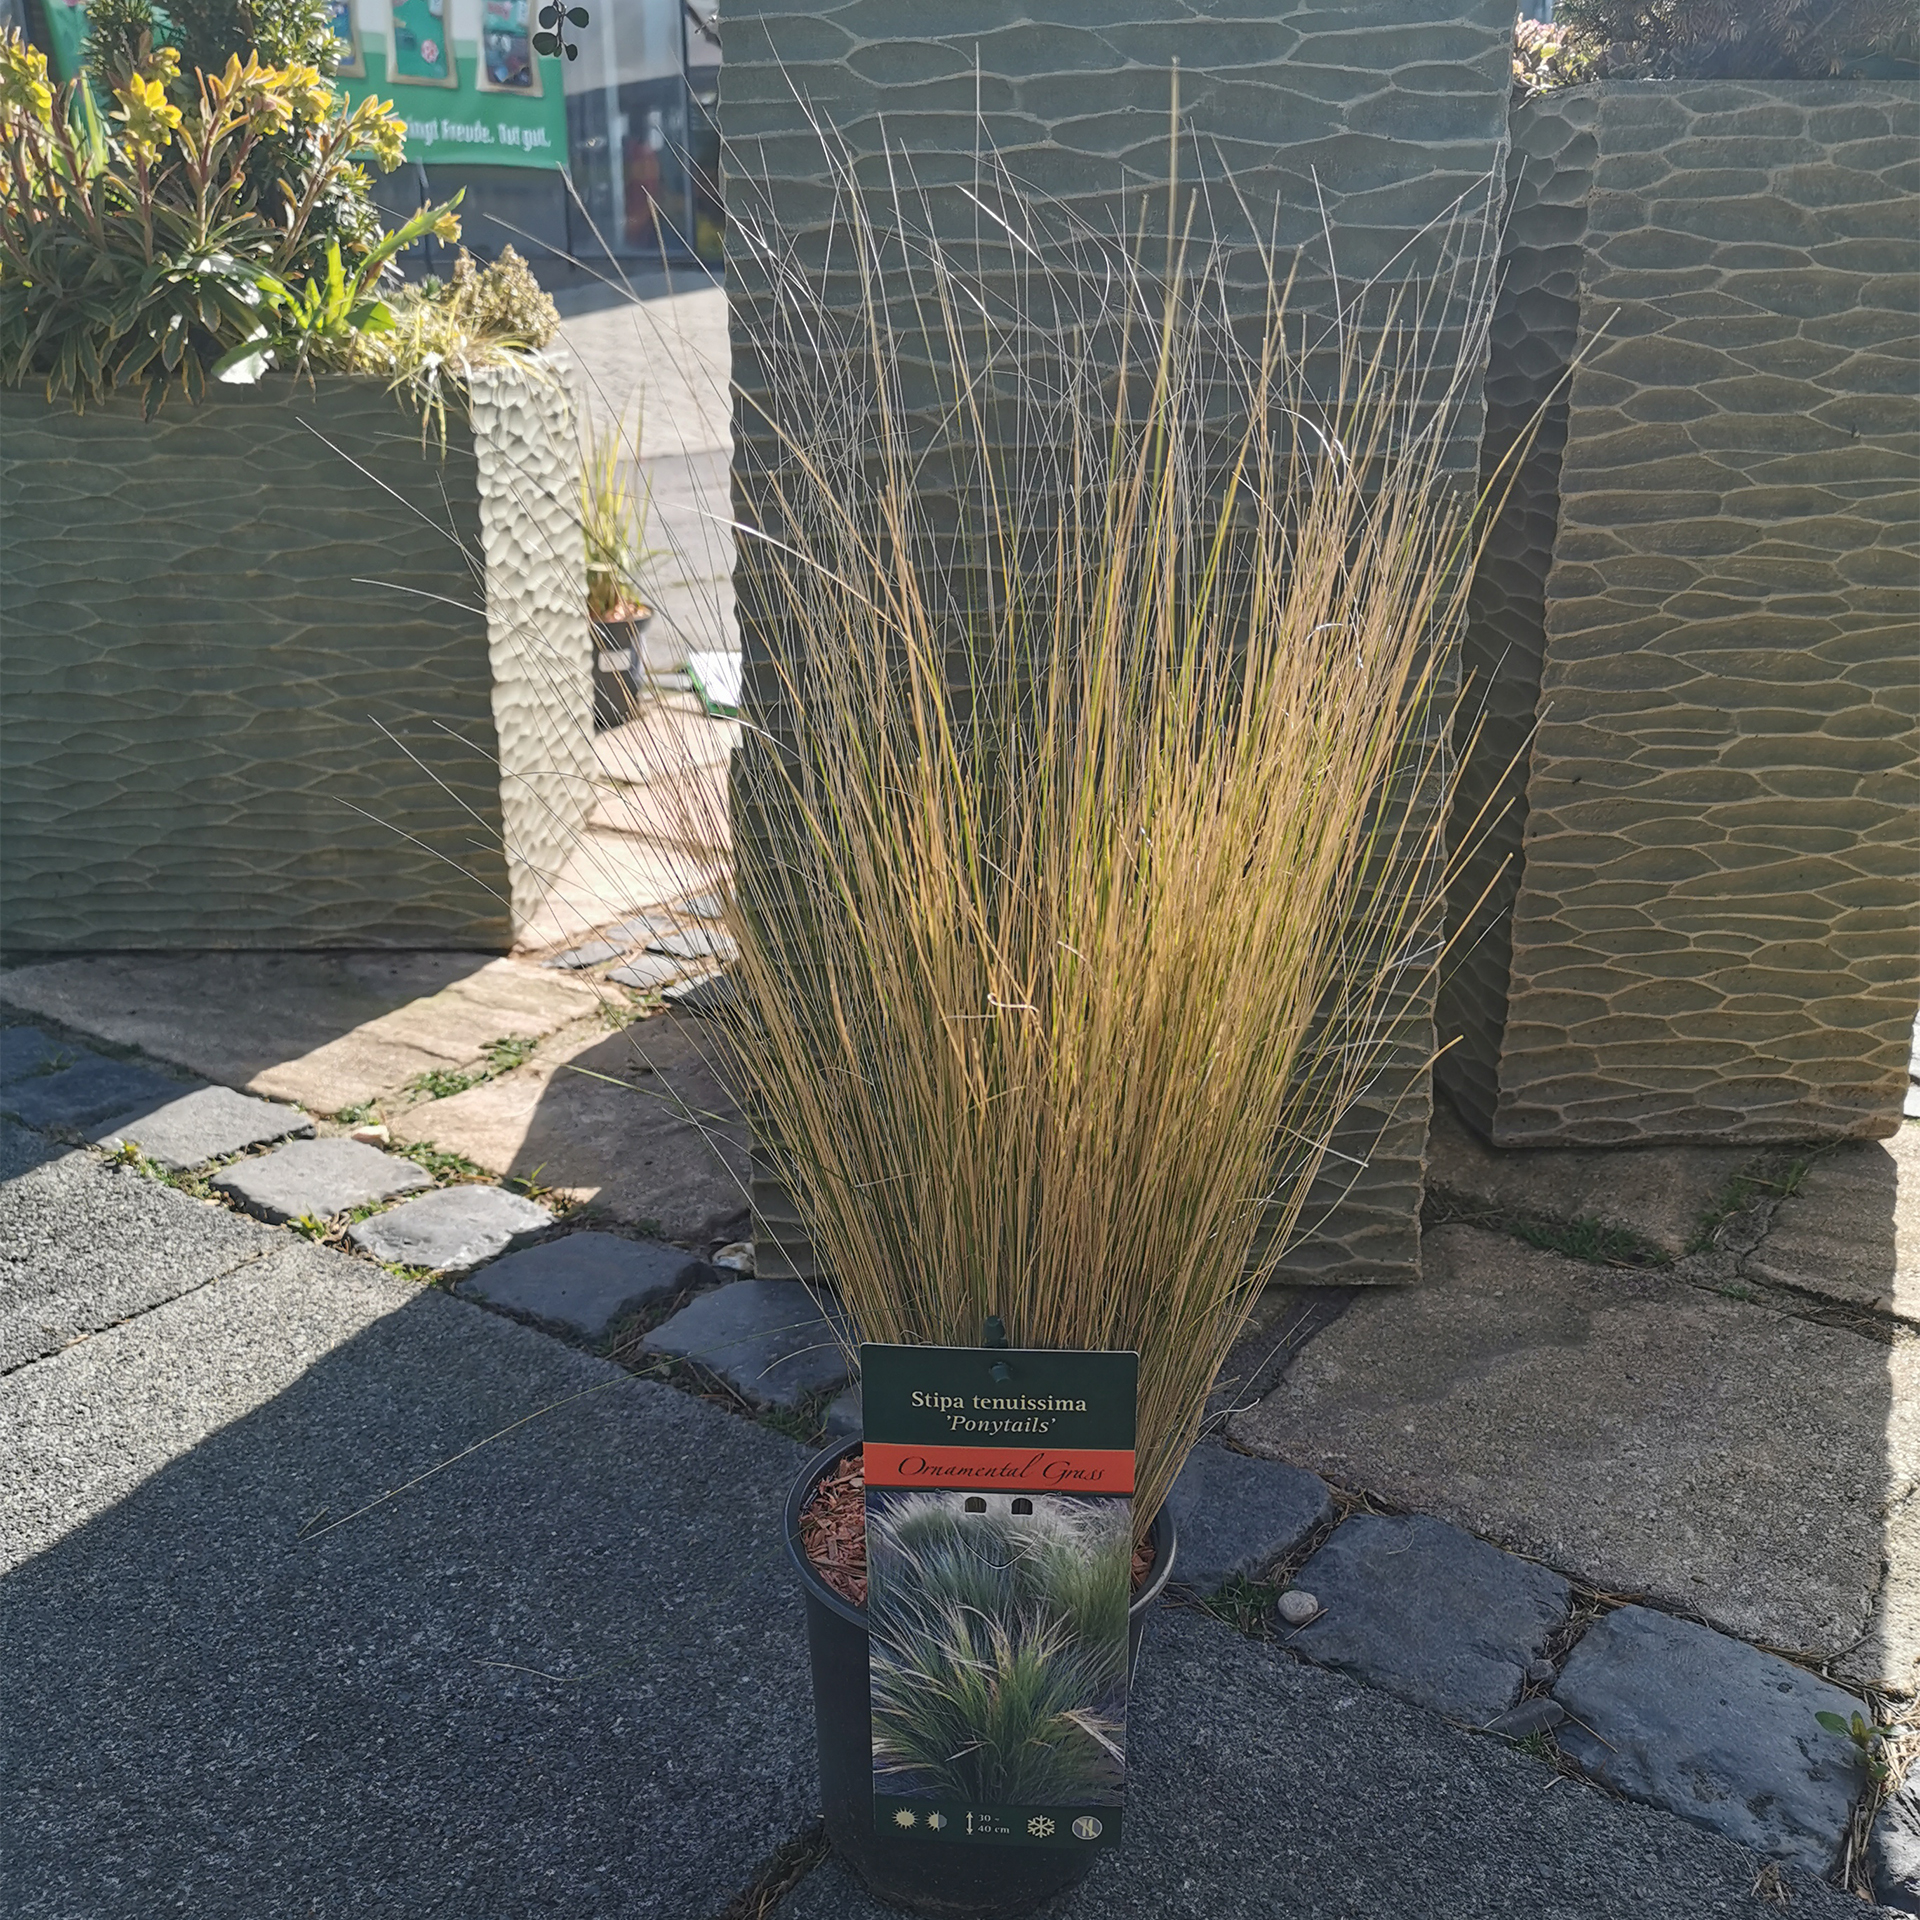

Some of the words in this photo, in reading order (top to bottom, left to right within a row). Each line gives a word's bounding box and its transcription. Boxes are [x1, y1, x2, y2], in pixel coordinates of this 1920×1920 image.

[407, 117, 439, 146] ingt
[911, 1390, 965, 1412] Stipa
[973, 1394, 1087, 1412] tenuissima
[898, 1453, 1045, 1479] Ornamental
[1042, 1460, 1105, 1485] Grass
[978, 1814, 991, 1822] 30
[977, 1825, 992, 1833] 40
[994, 1826, 1010, 1834] cm
